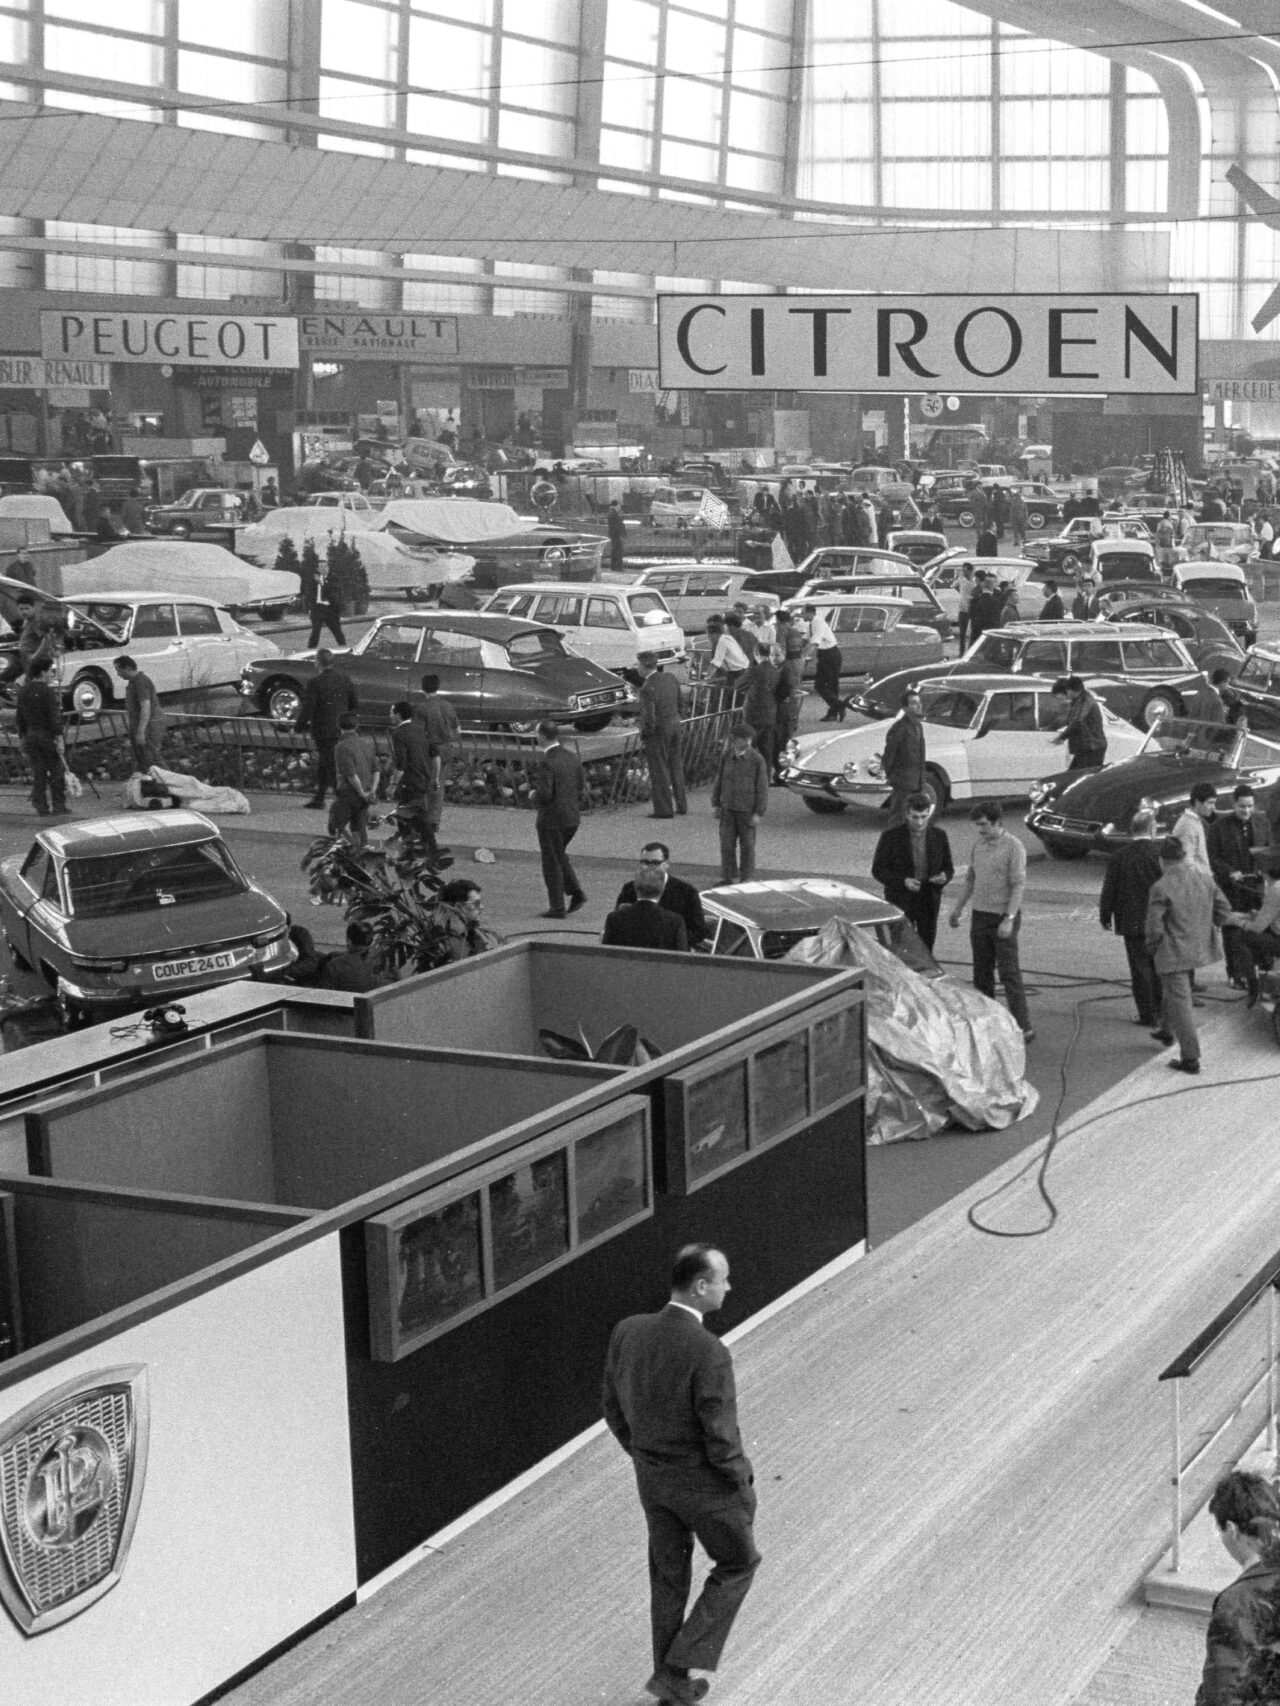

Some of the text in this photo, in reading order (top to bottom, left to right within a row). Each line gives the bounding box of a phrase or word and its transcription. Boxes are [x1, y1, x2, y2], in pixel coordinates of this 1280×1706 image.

[61, 316, 277, 360] PEUGEOT
[675, 303, 1179, 382] CITROEN
[154, 954, 230, 979] COUPE 24 CT
